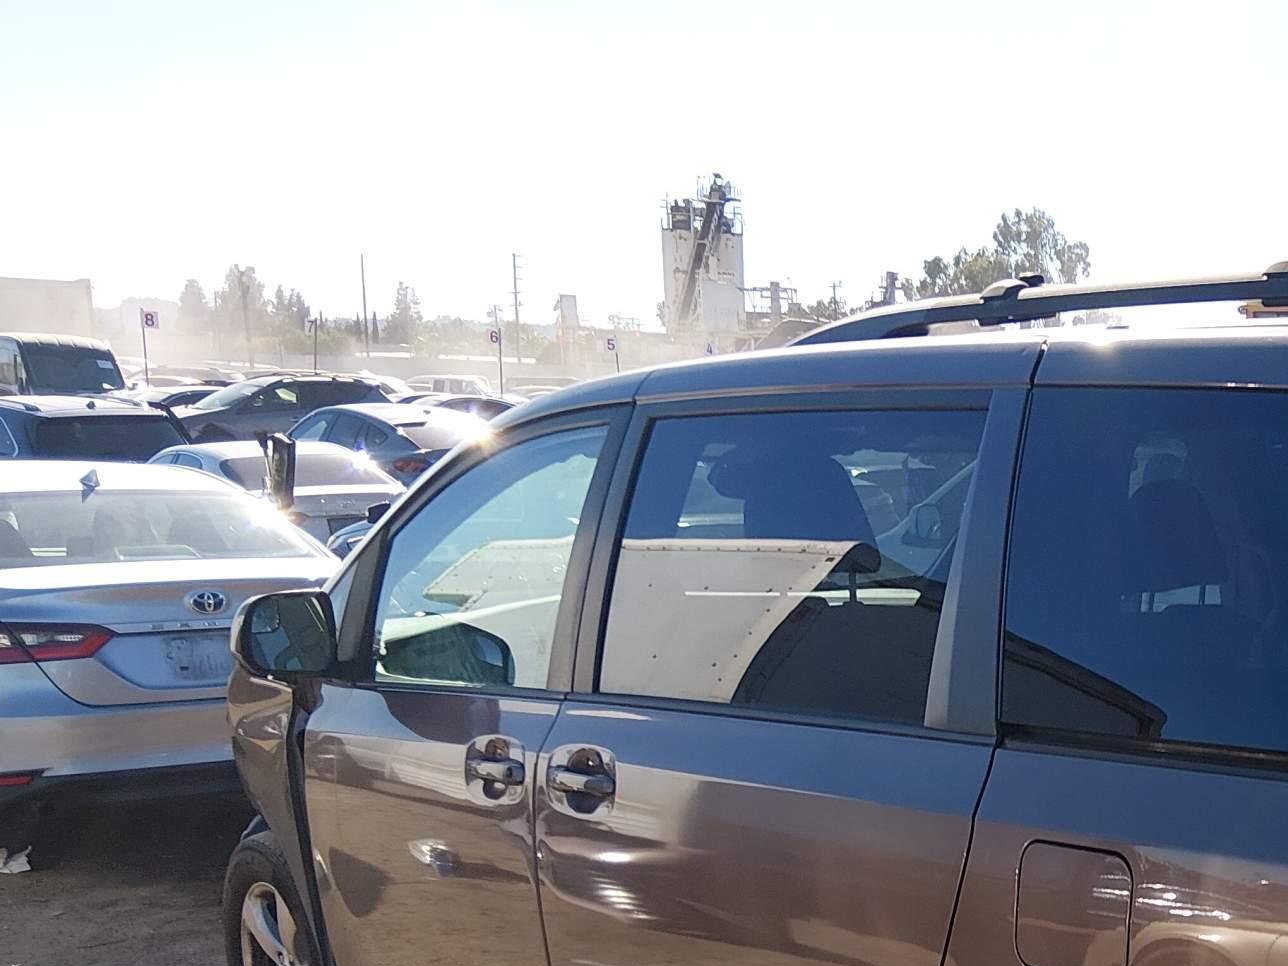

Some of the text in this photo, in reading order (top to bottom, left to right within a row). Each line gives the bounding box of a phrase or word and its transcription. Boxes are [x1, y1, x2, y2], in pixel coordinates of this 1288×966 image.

[144, 313, 155, 327] 8
[307, 320, 314, 333] 7
[489, 331, 499, 344] 6
[607, 338, 616, 351] 5
